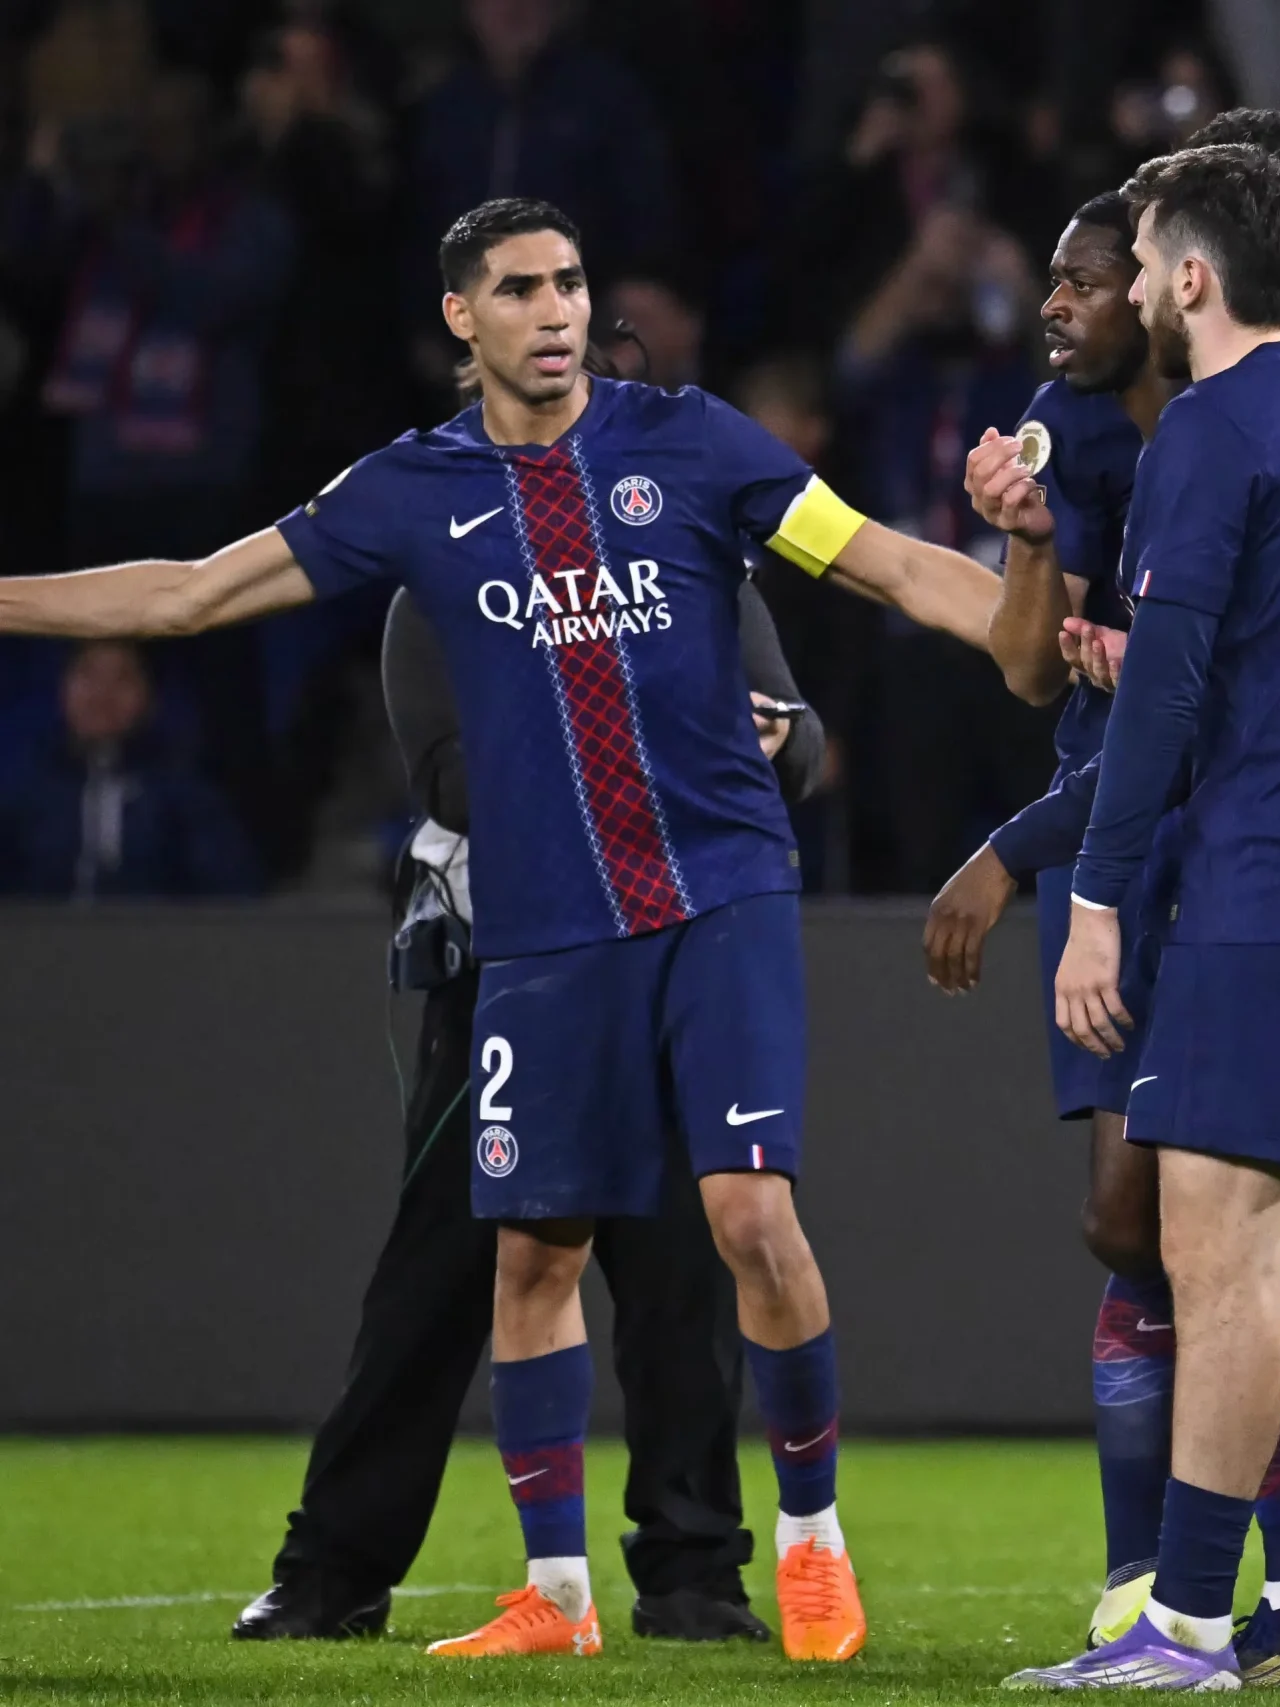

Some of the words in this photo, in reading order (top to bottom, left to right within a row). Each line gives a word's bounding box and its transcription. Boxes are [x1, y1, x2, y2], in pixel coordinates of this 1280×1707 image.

[616, 478, 651, 493] PARIS
[478, 559, 666, 630] QATAR
[532, 602, 672, 649] AIRWAYS
[479, 1036, 513, 1121] 2
